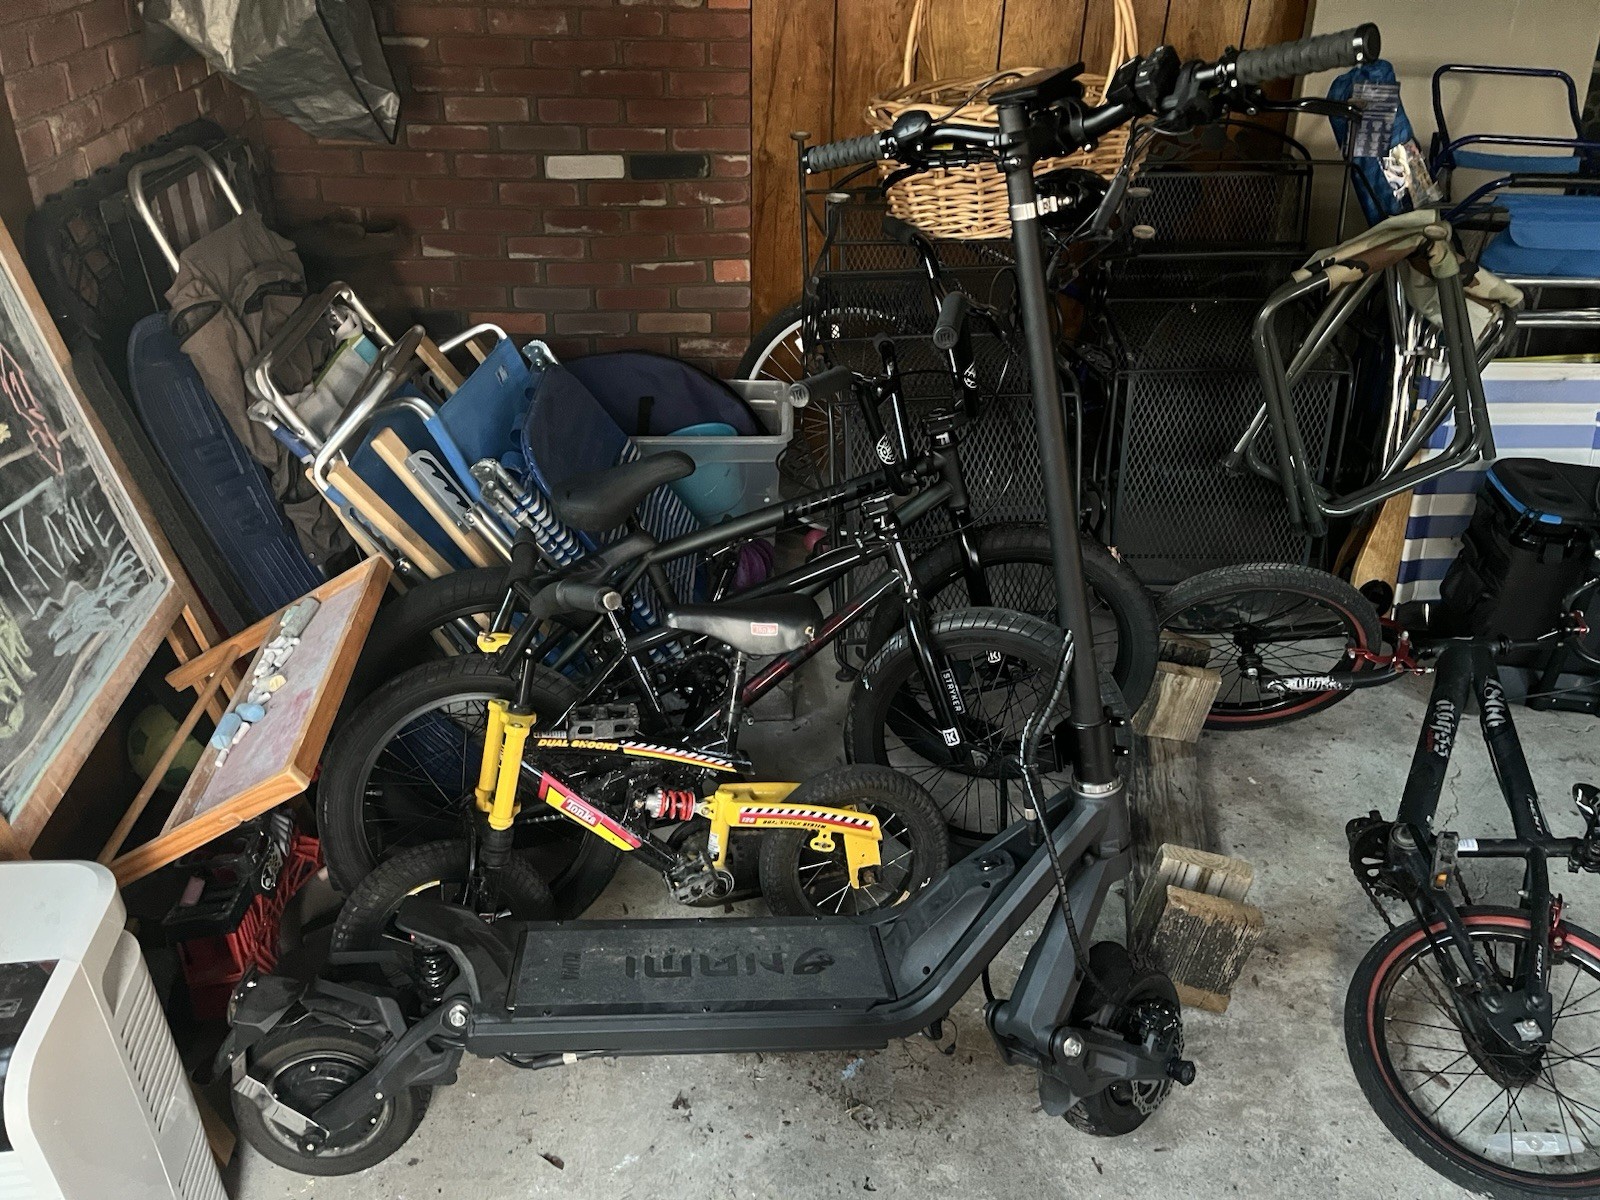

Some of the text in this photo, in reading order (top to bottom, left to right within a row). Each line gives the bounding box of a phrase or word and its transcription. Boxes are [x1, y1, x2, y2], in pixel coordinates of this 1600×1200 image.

[942, 672, 963, 712] STRYKER
[538, 739, 569, 748] DUAL
[564, 799, 598, 826] Tonka
